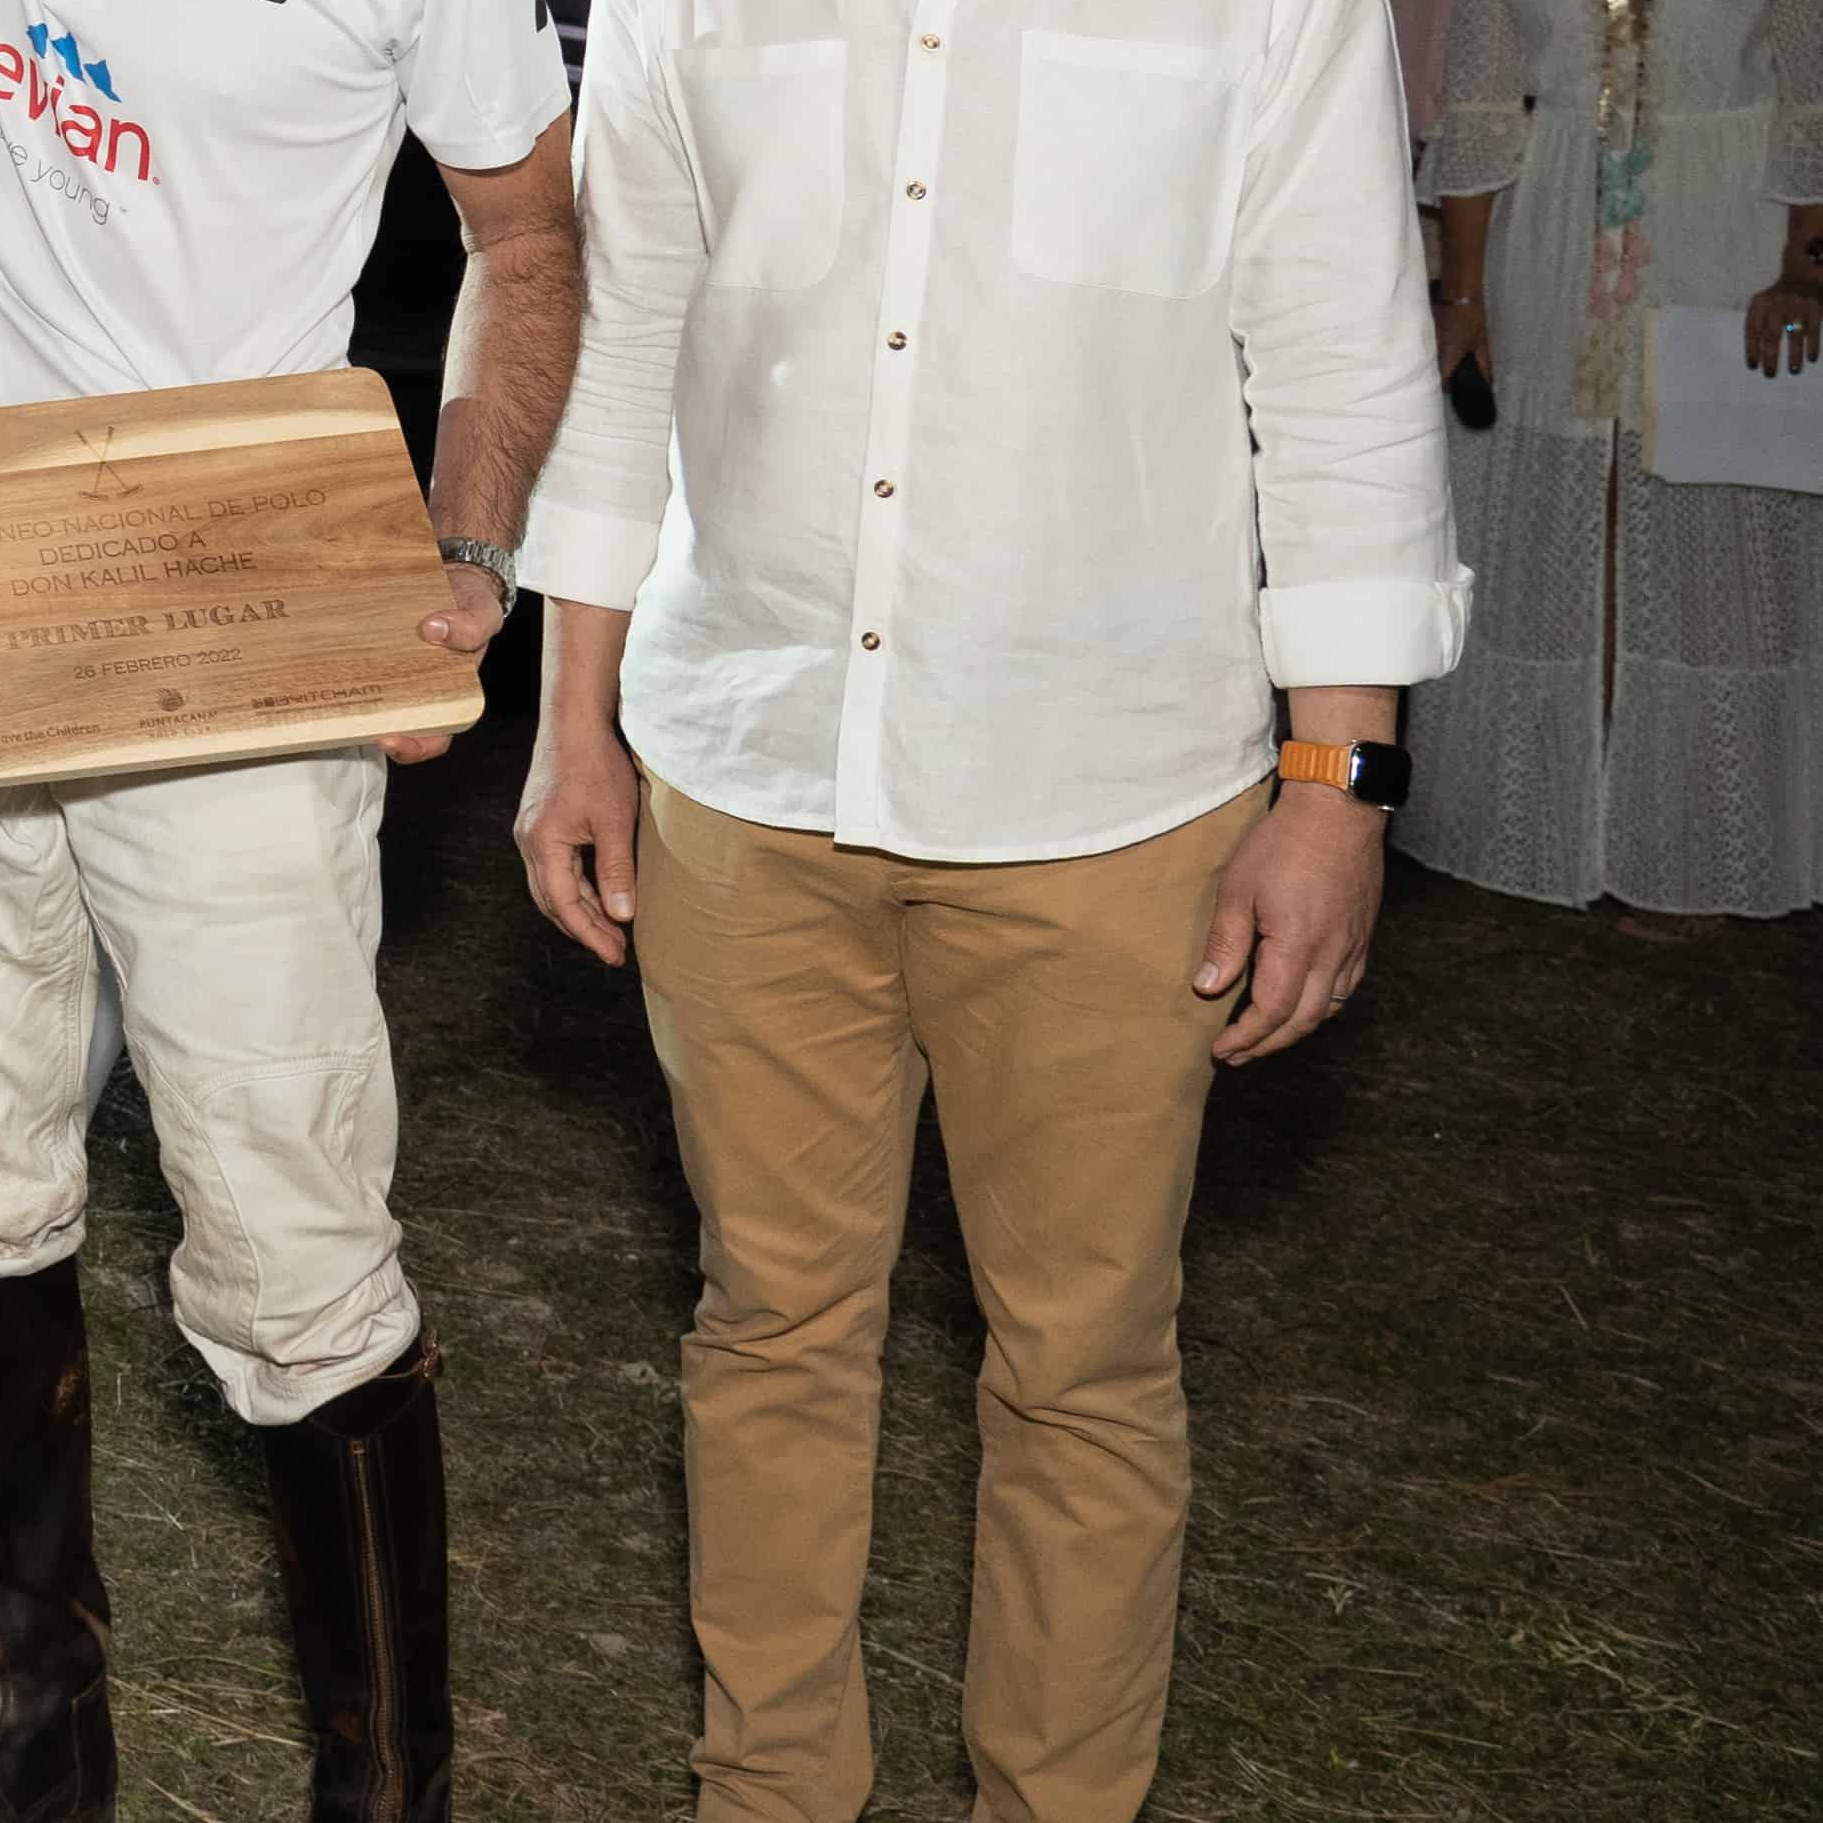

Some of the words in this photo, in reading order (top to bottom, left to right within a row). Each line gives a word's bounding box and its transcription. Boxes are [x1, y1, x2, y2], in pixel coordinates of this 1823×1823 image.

[30, 160, 111, 225] young
[62, 504, 201, 535] NACIONAL
[208, 497, 245, 519] DE
[253, 488, 326, 514] POLO
[38, 533, 179, 567] DEDICADO
[188, 530, 208, 549] A
[10, 575, 72, 597] DON
[80, 566, 157, 591] KALIL
[162, 552, 259, 578] HACHE
[5, 614, 153, 651] PRIMER
[164, 598, 290, 633] LUGAR
[73, 664, 96, 680] 26
[102, 653, 192, 676] FEBRERO
[198, 648, 244, 667] 2022
[22, 730, 45, 742] the
[46, 722, 100, 738] Children
